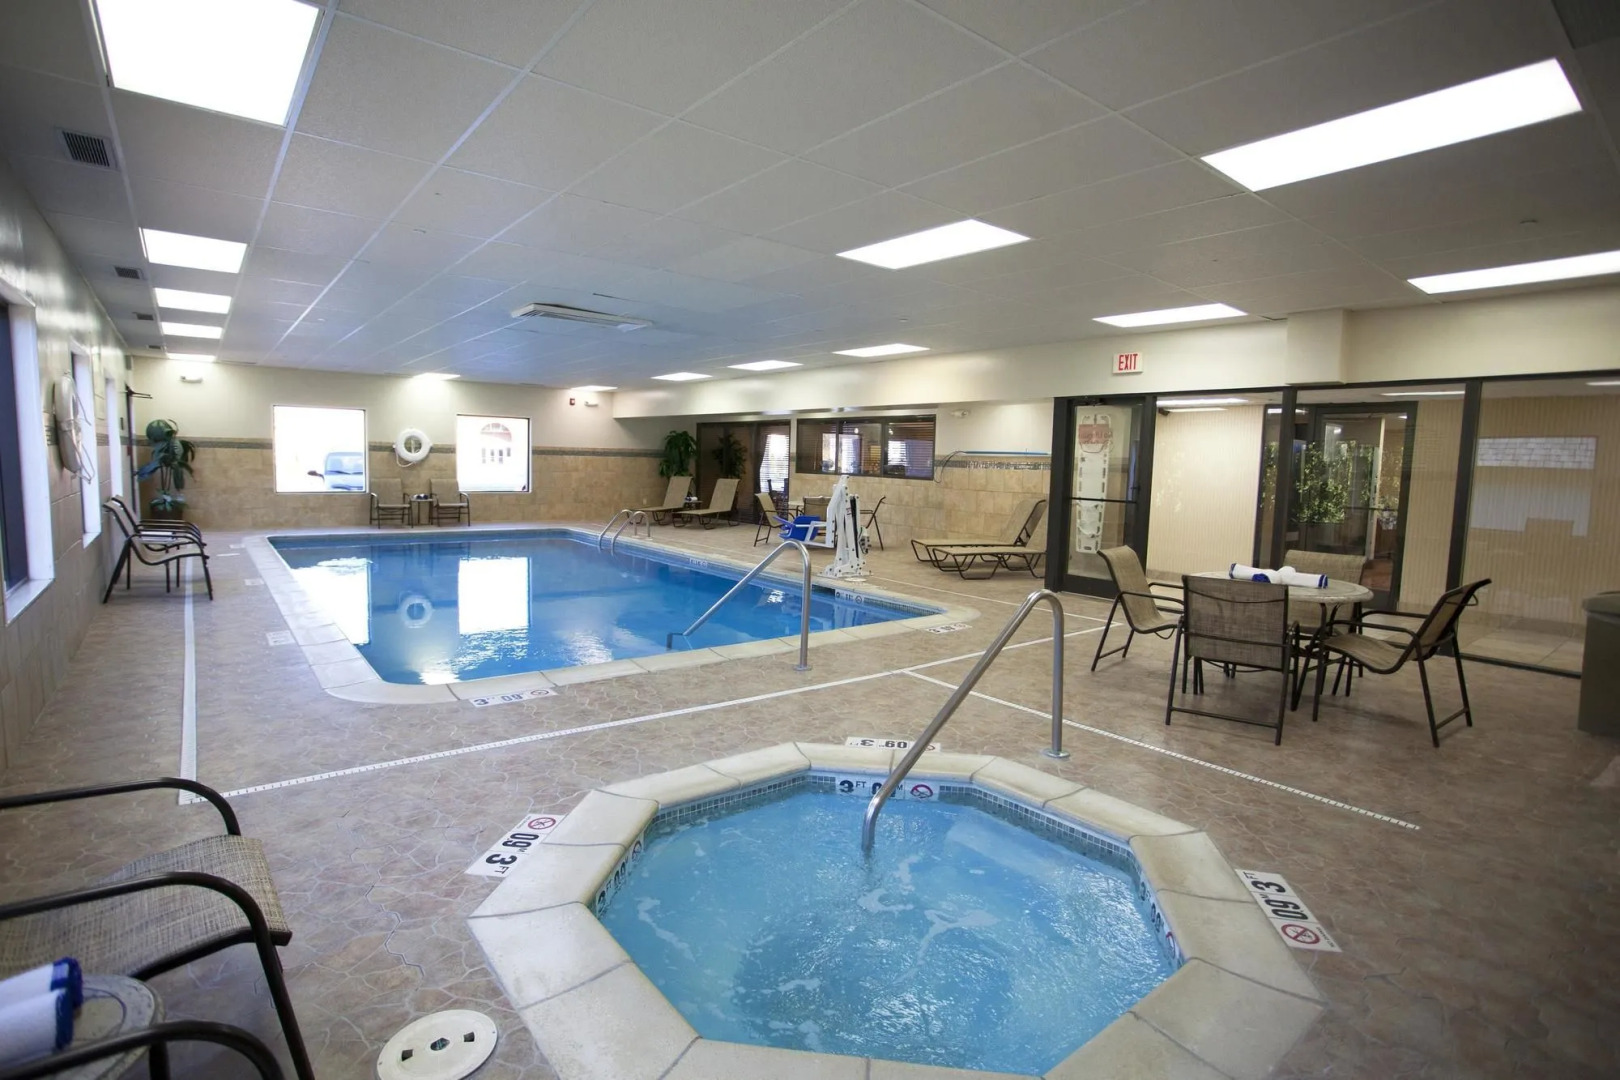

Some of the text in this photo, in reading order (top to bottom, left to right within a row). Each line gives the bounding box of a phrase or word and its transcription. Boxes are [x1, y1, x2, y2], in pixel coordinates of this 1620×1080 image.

[1118, 353, 1138, 371] EXIT
[839, 780, 854, 793] 3
[855, 781, 867, 789] FT
[485, 853, 518, 866] 3
[494, 865, 510, 875] FT
[1243, 871, 1259, 880] FT
[1251, 880, 1286, 893] 3
